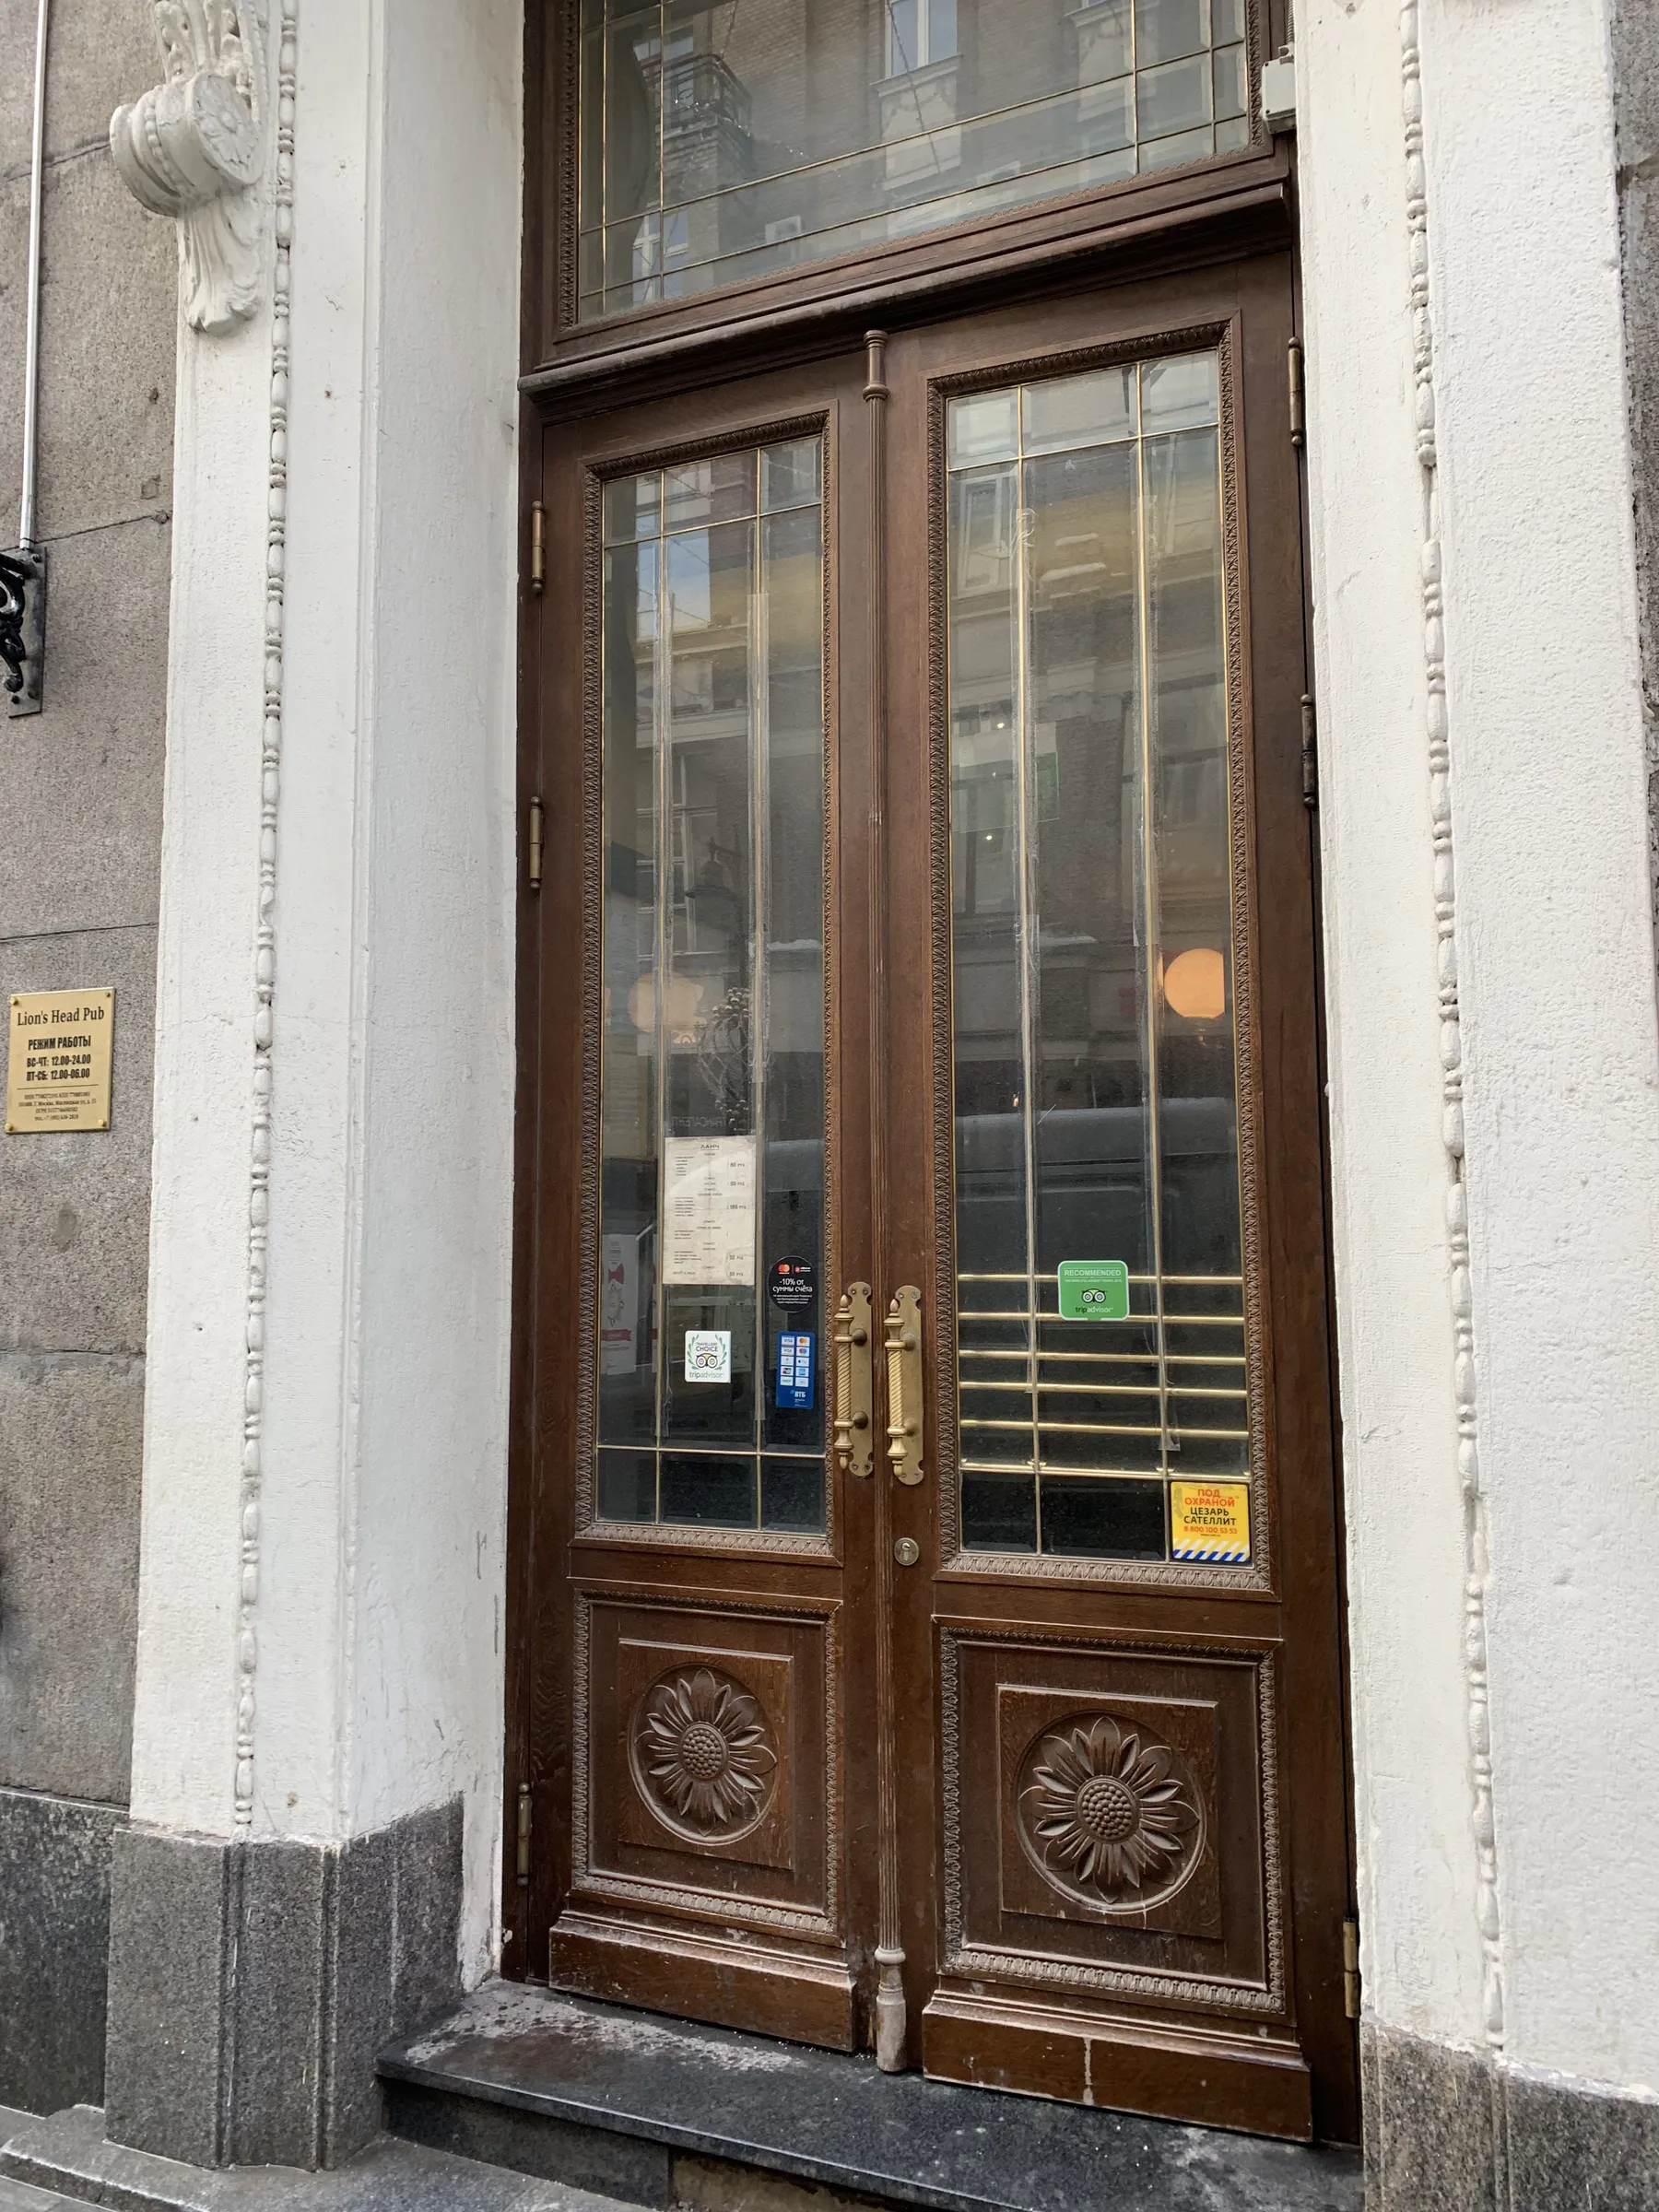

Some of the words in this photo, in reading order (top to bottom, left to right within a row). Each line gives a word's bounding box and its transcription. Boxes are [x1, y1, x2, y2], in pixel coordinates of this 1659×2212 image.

[18, 1010, 48, 1026] Lion's
[51, 1007, 80, 1023] Head
[83, 1006, 104, 1021] Pub
[28, 1038, 55, 1051] РЕЖИМ
[57, 1035, 91, 1049] РАБОТЫ
[27, 1056, 49, 1067] ВС-ЧТ:
[51, 1053, 91, 1066] 12.00-24.00
[26, 1070, 48, 1081] ПТ-СБ:
[50, 1067, 90, 1080] 12.00-06.00
[779, 1277, 795, 1286] -10%
[1075, 1305, 1112, 1314] tripadvisor
[688, 1371, 724, 1379] tripadvisor
[1197, 1488, 1221, 1499] ПОД
[1184, 1497, 1235, 1507] ОХРАНОЙ
[1190, 1507, 1230, 1516] ЦЕЗАРЬ
[1183, 1515, 1237, 1525] САТЕЛЛИТ
